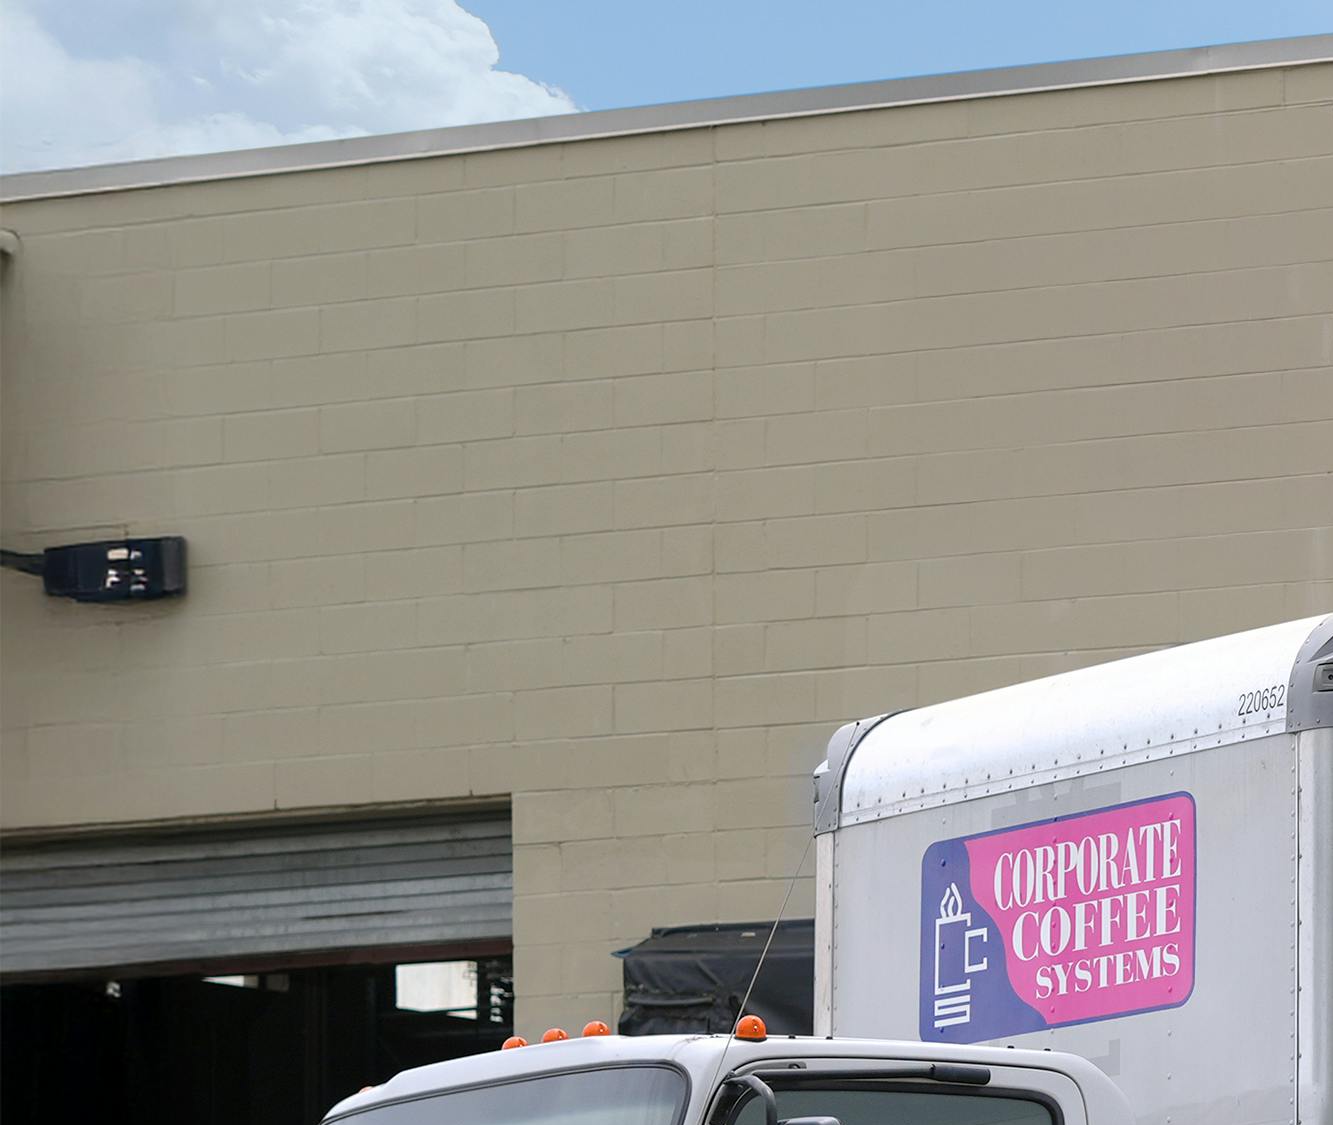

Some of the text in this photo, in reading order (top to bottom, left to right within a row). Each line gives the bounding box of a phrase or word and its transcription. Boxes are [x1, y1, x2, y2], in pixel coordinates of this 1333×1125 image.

[1237, 683, 1286, 716] 220652
[993, 819, 1182, 911] CORPORATE
[1011, 883, 1182, 962] COFFEE
[1035, 942, 1181, 1000] SYSTEMS
